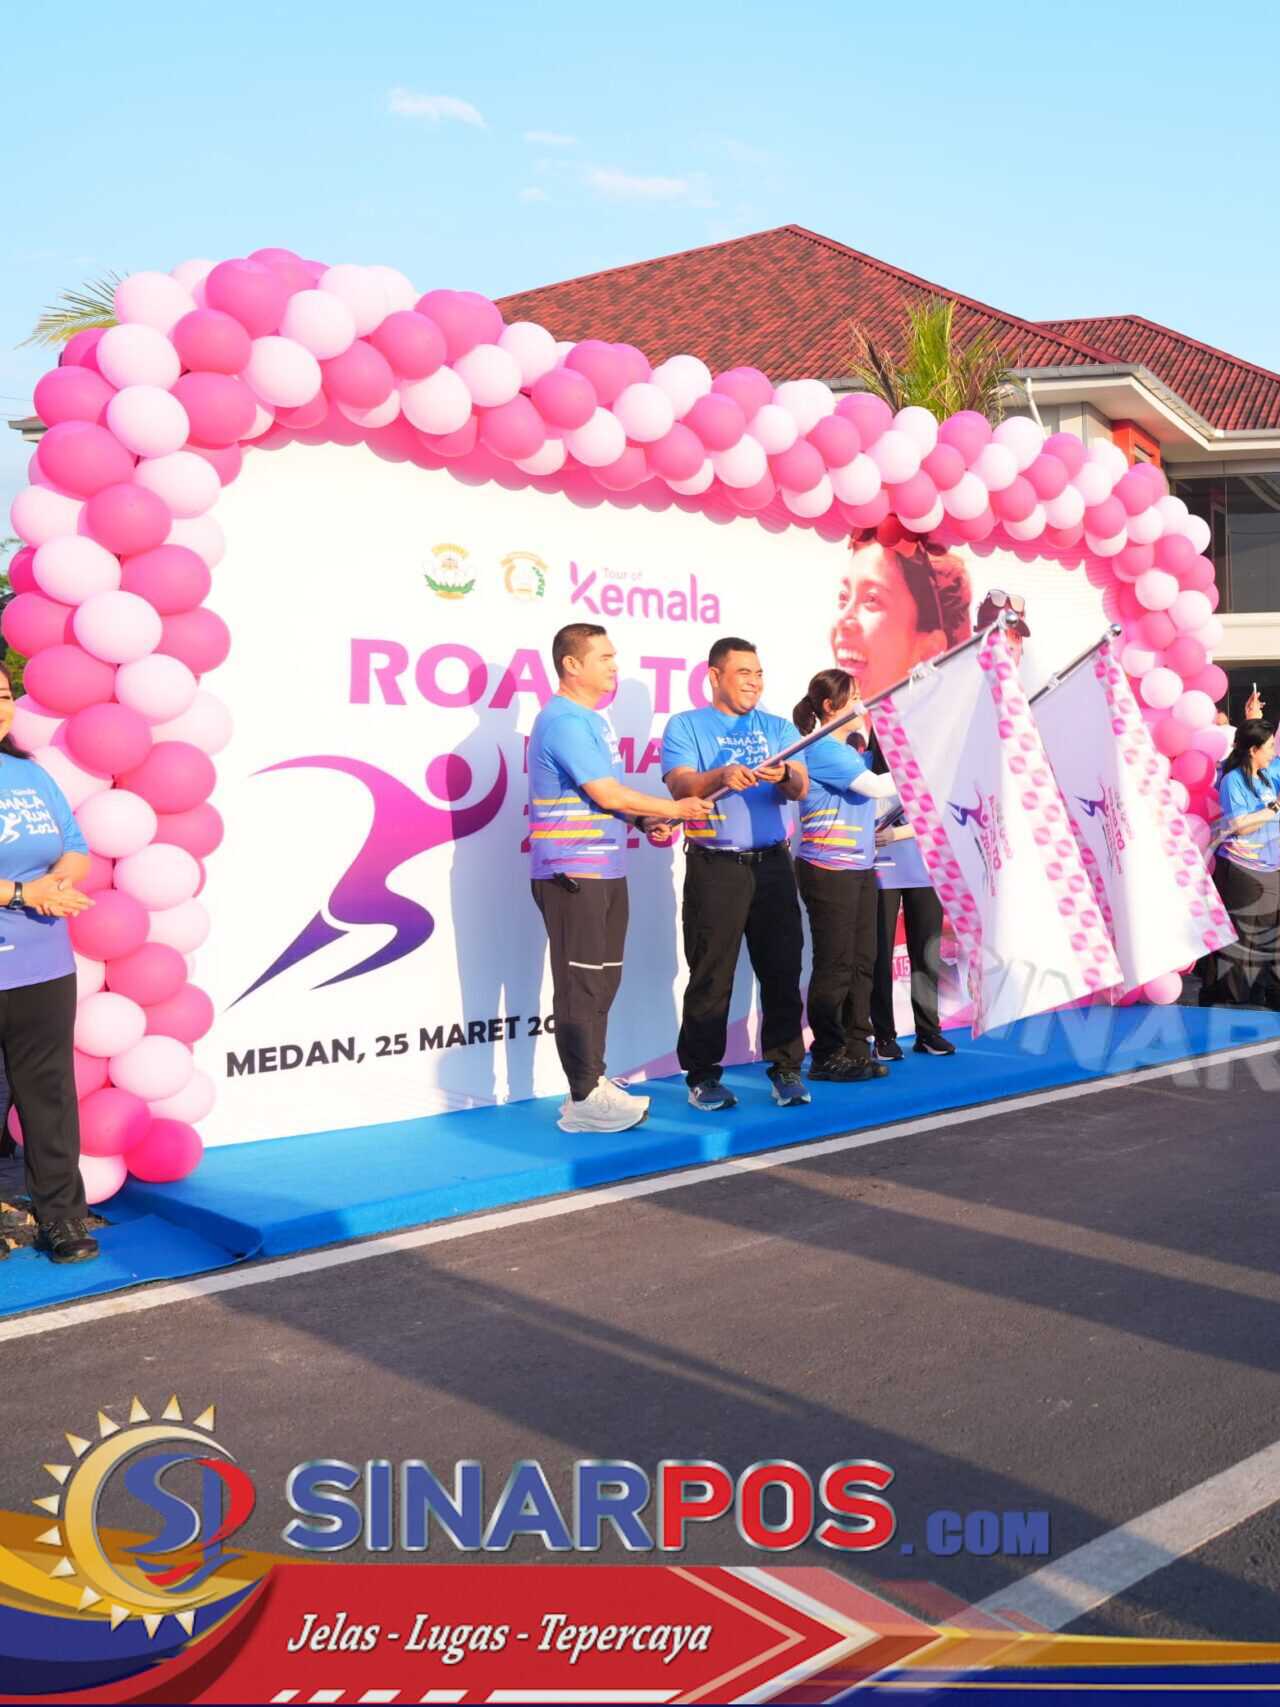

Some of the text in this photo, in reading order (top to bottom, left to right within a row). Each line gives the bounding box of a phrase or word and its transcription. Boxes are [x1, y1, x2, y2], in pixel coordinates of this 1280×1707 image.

[569, 561, 721, 625] Kemala
[603, 568, 627, 580] Tour
[349, 638, 618, 710] ROA
[226, 1036, 366, 1078] MEDAN,
[375, 1033, 409, 1058] 25
[419, 1015, 520, 1052] MARET
